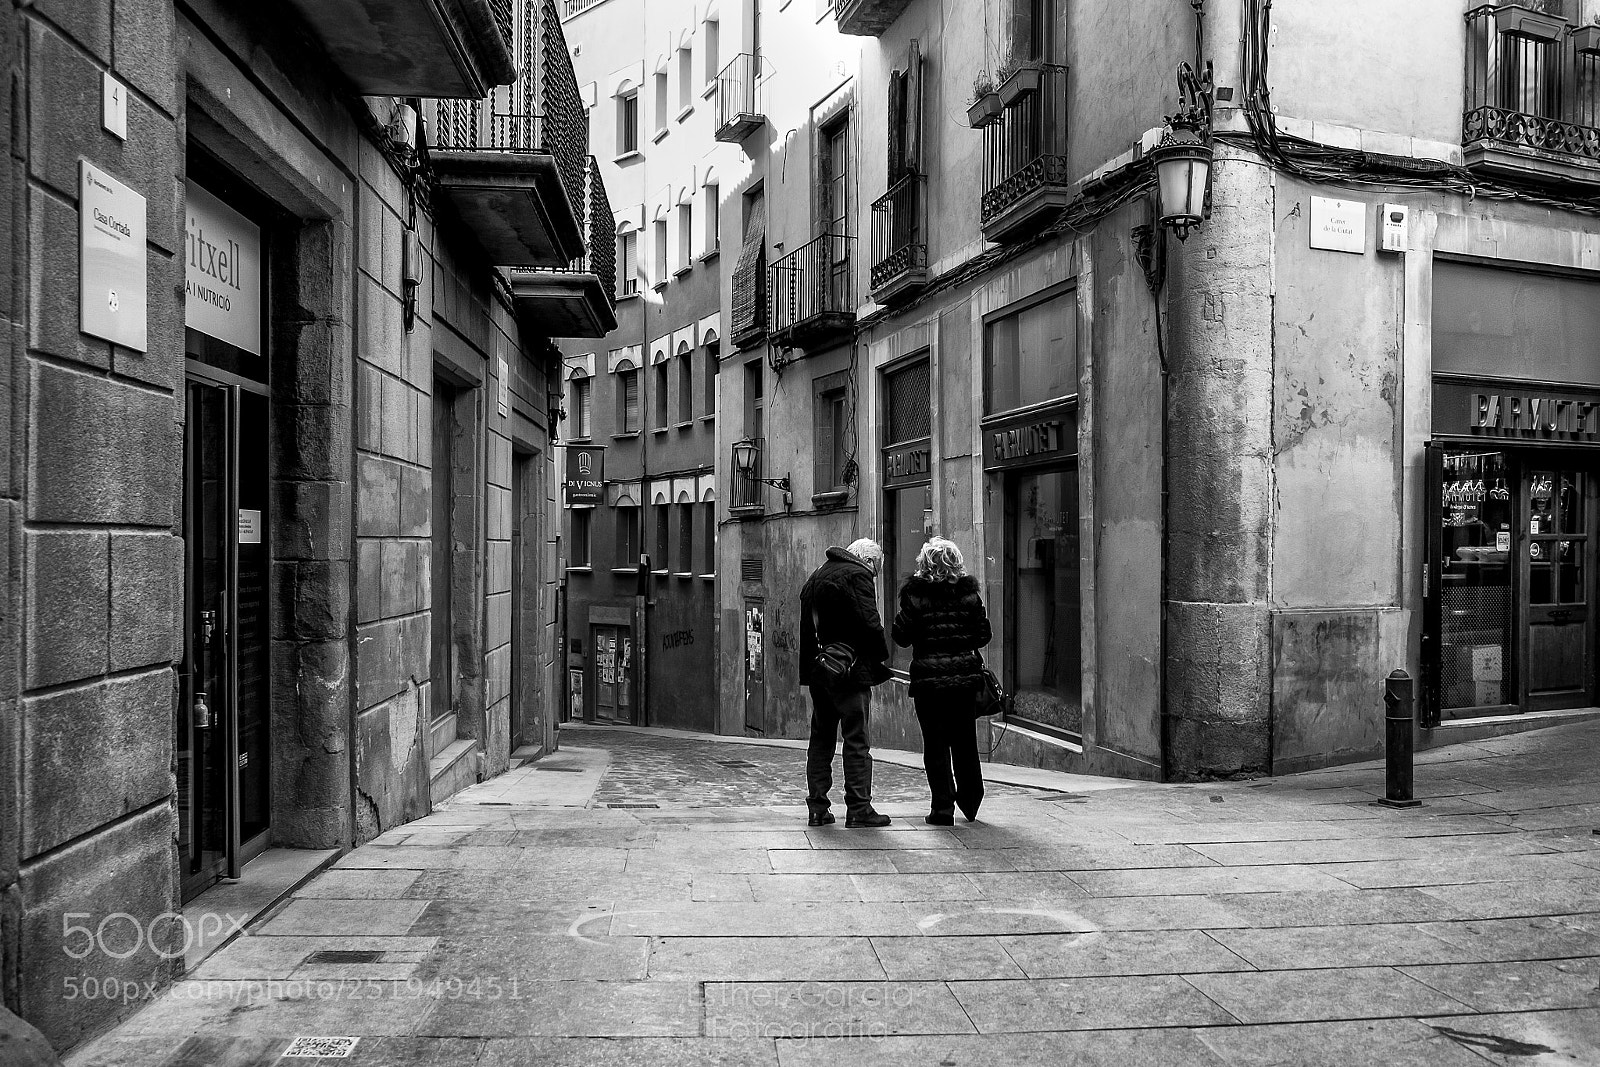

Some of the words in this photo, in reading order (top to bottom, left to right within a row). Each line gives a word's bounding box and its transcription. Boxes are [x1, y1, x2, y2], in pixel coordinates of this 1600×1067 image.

[112, 87, 119, 106] 4
[93, 207, 108, 226] Casa
[108, 215, 131, 238] Cortada
[197, 284, 231, 312] NUTRICIÓ
